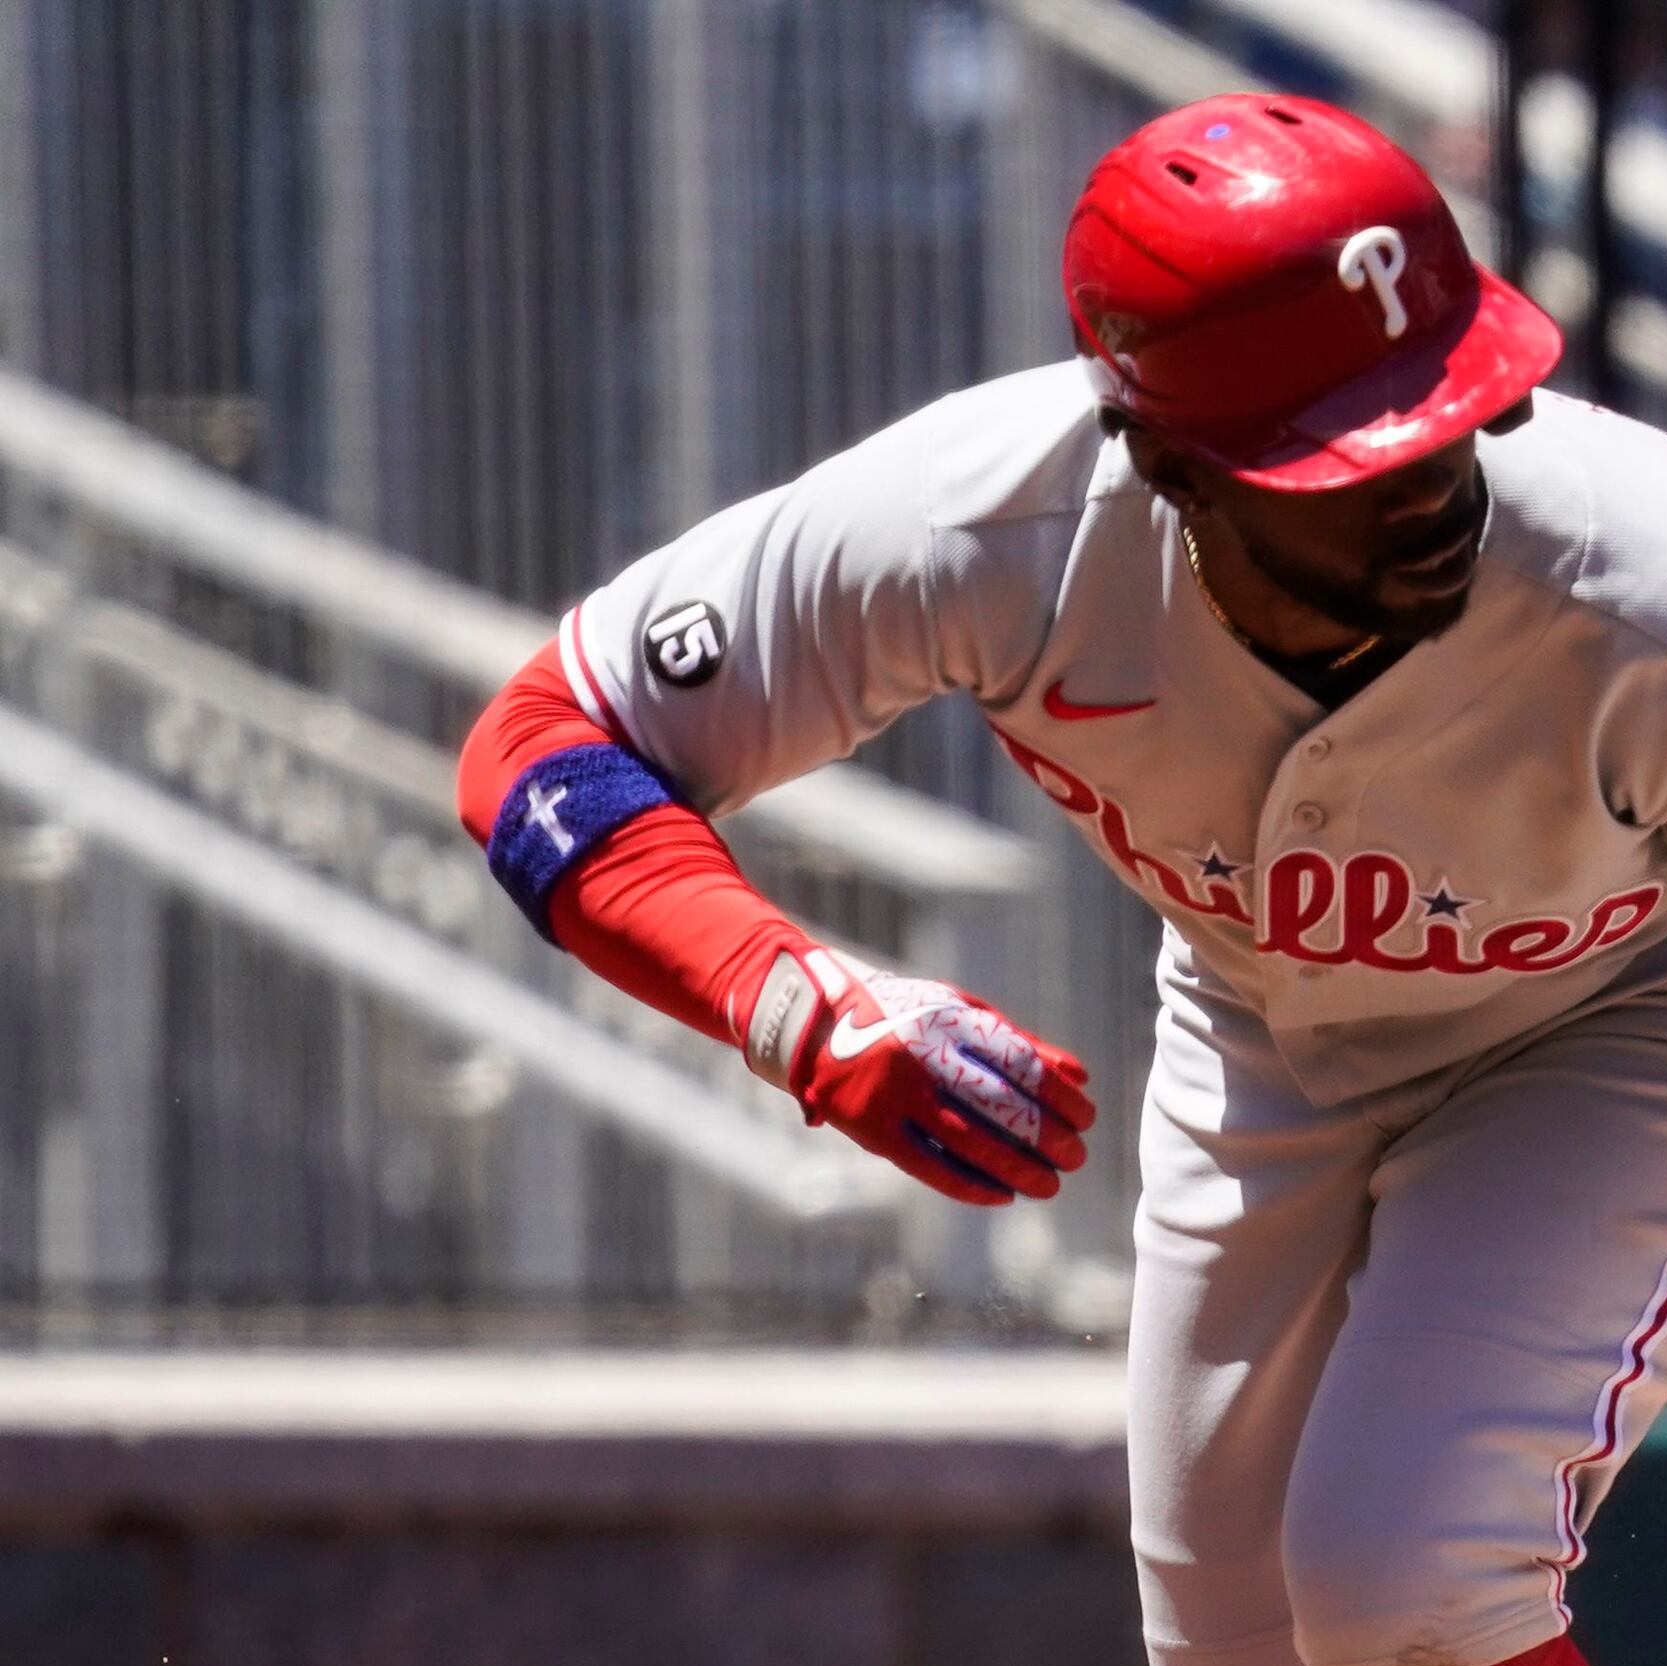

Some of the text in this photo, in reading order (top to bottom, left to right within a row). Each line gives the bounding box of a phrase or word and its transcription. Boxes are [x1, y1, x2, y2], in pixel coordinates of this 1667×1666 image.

[1338, 225, 1407, 339] P
[648, 602, 720, 677] 15
[985, 711, 1665, 976] Phillies
